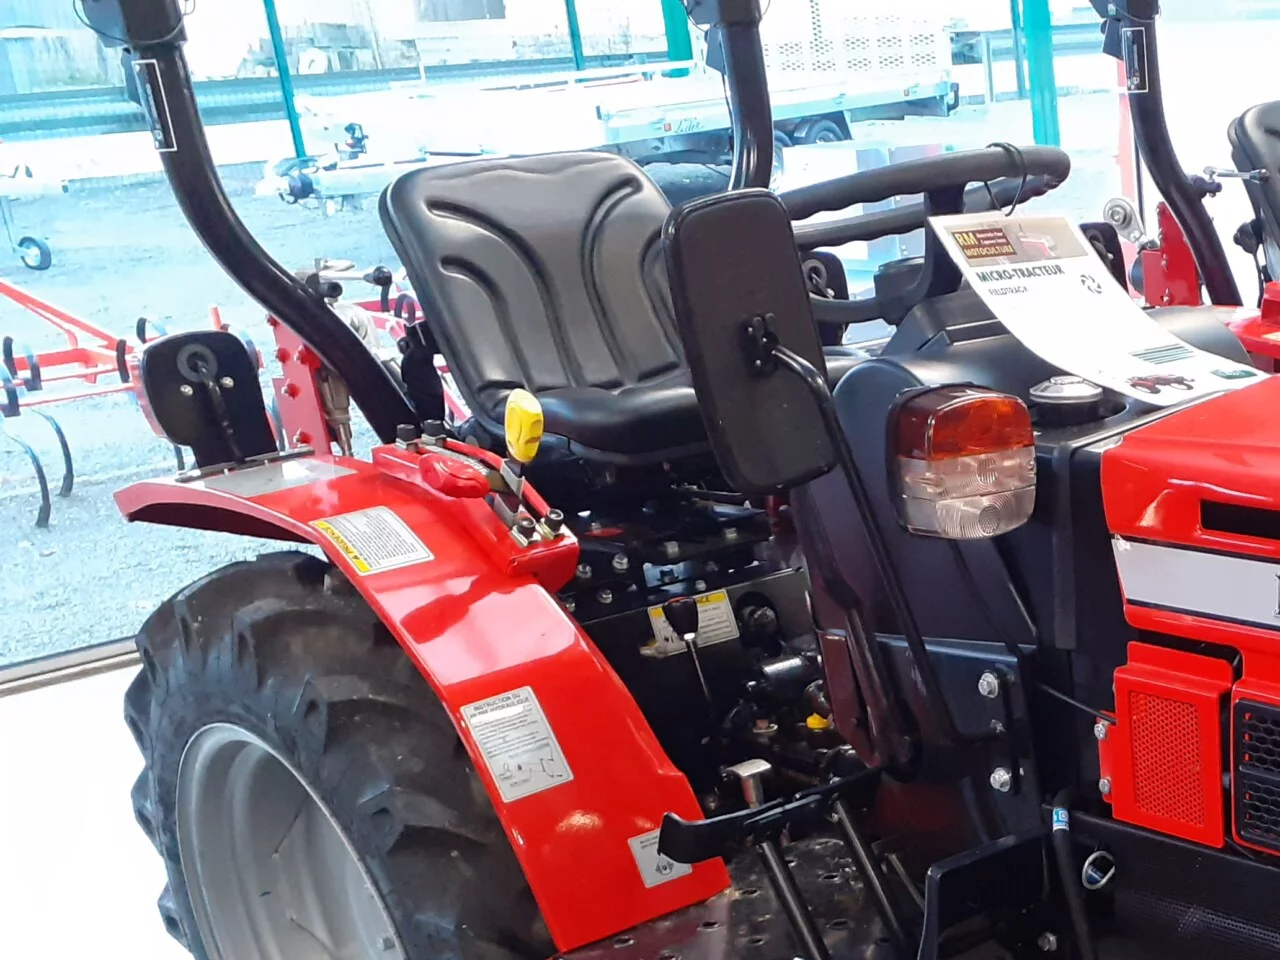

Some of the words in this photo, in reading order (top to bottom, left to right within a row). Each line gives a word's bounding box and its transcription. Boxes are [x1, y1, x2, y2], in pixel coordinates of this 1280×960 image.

[954, 231, 978, 246] RM
[964, 244, 1014, 257] MOTOCULTURE
[976, 264, 1065, 283] MICRO-TRACTEUR
